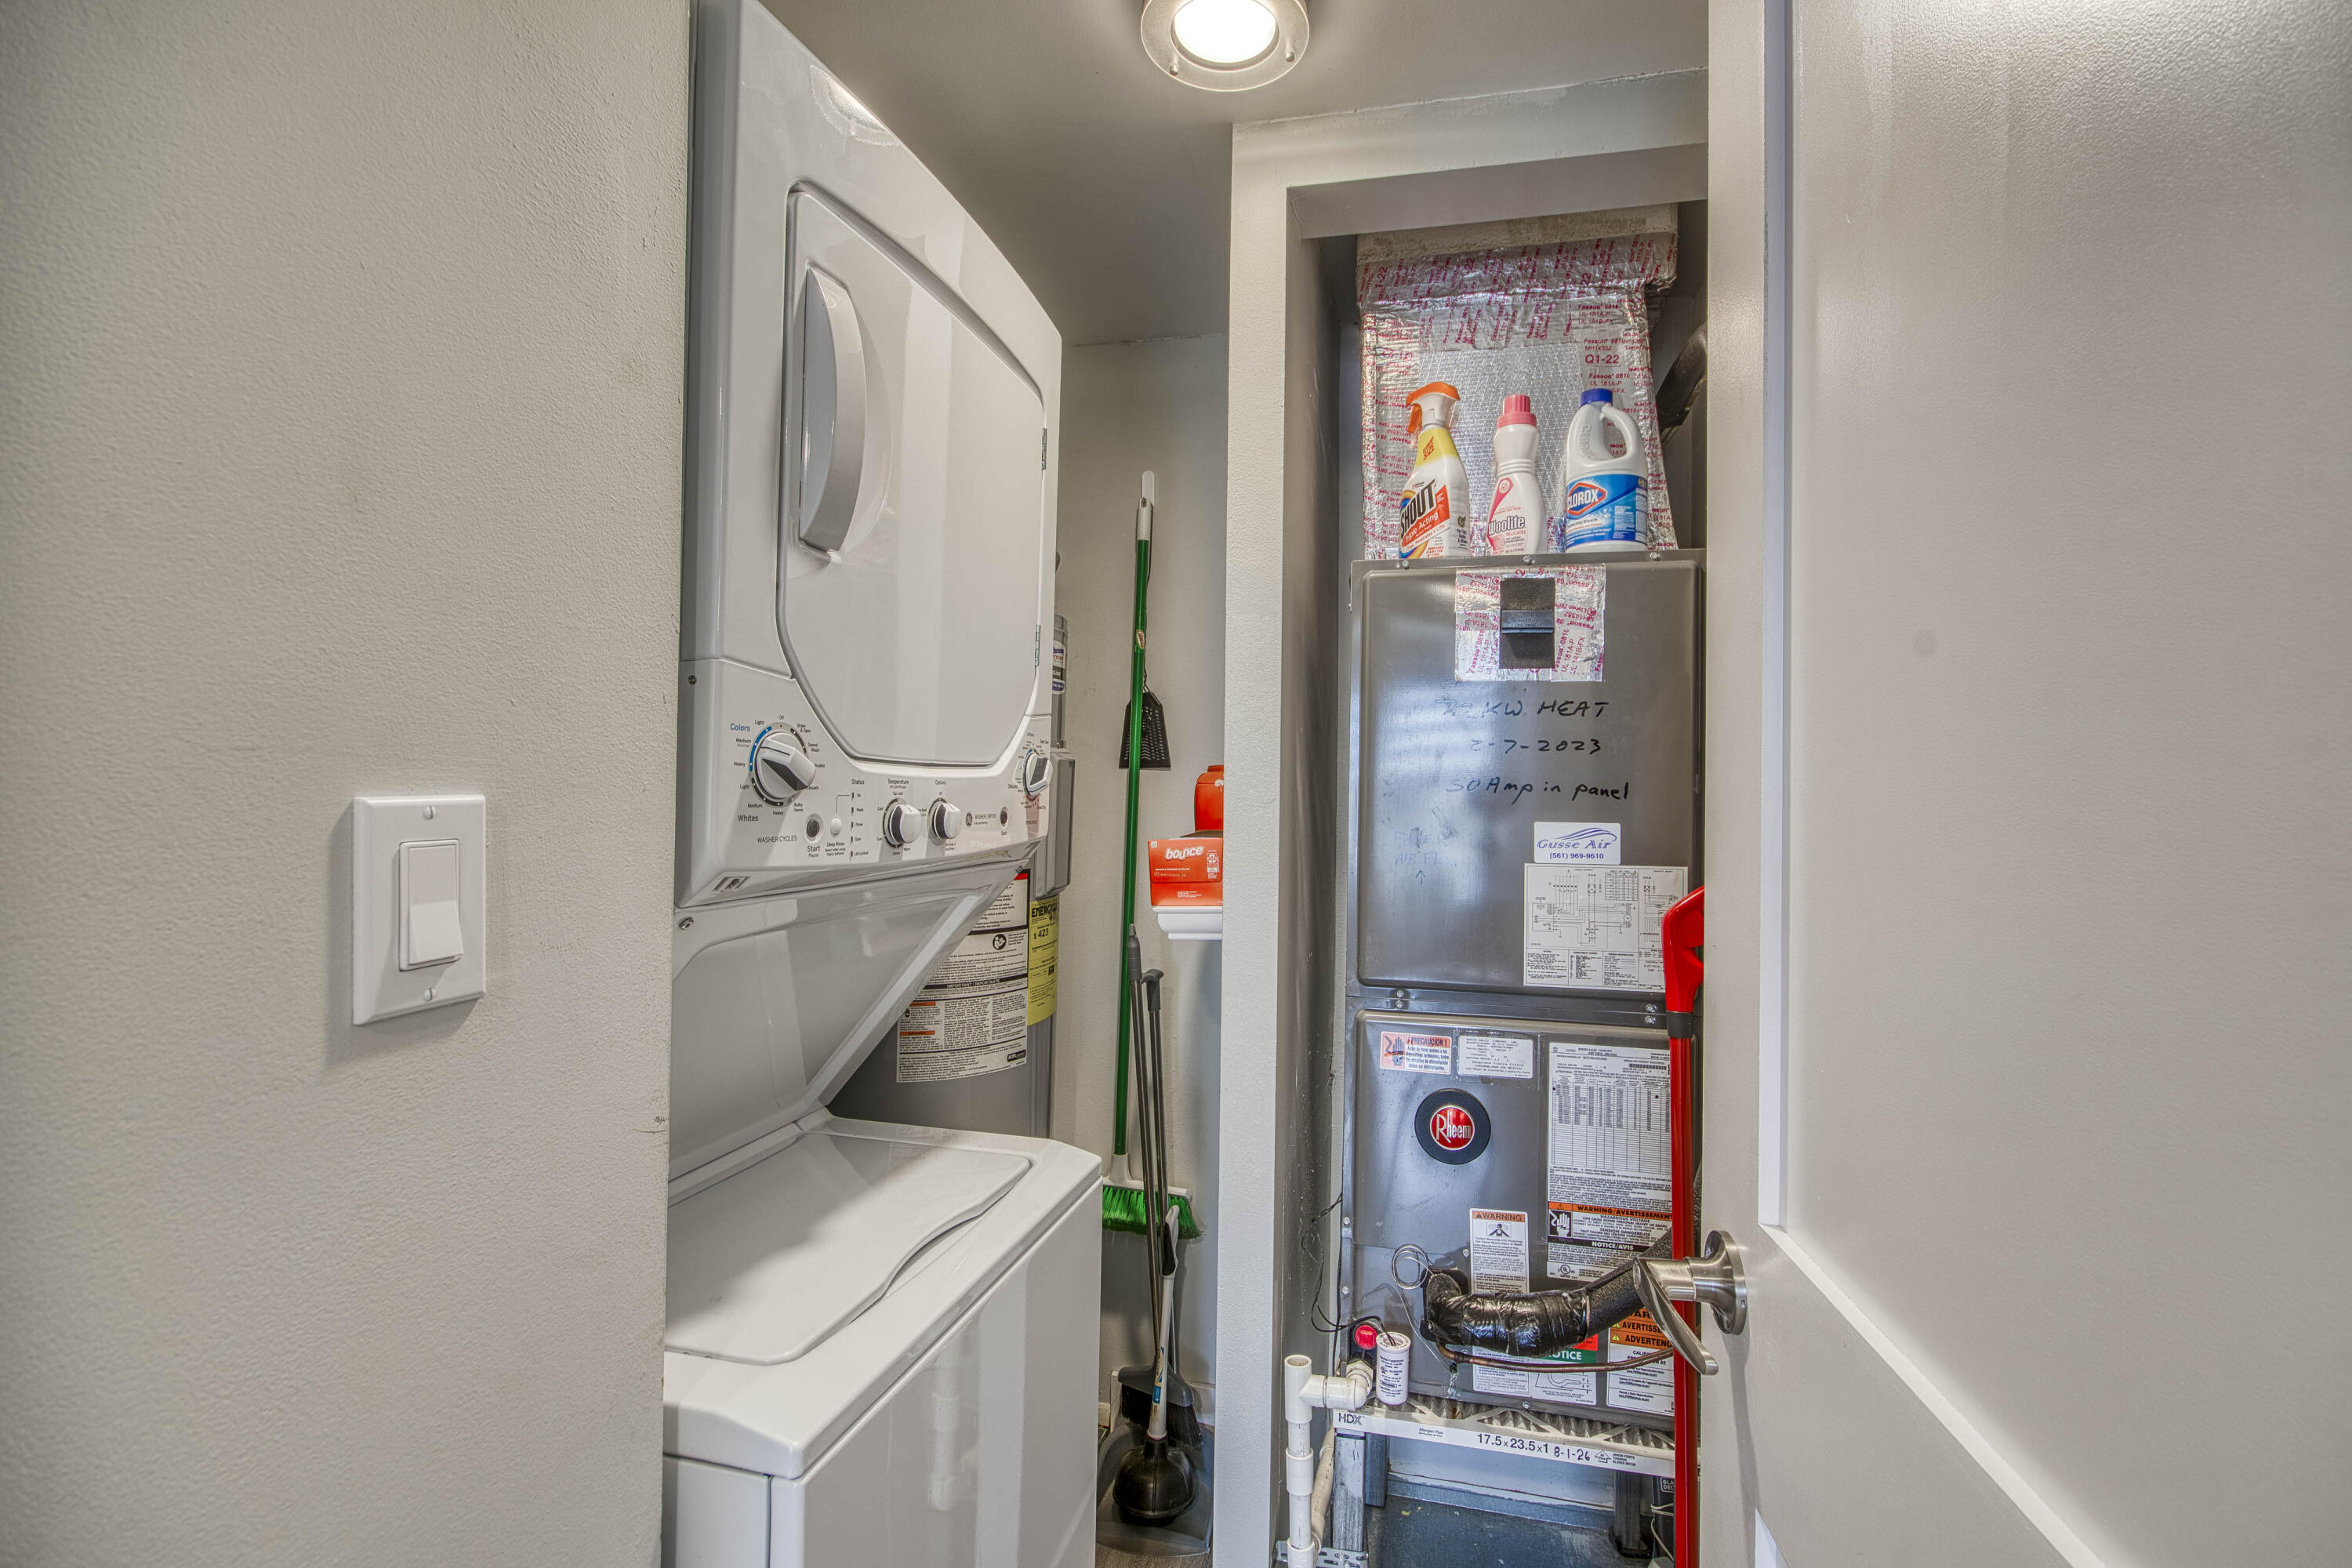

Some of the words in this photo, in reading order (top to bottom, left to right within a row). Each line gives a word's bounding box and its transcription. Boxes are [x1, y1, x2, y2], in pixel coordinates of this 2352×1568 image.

[1584, 354, 1620, 365] Q1-22
[1400, 478, 1436, 539] SHOUT
[1418, 513, 1439, 528] Acting
[1488, 515, 1526, 535] Woolite
[1537, 700, 1610, 717] HEAT
[730, 722, 750, 732] Colors
[1469, 739, 1602, 755] 2-7-2023
[1543, 782, 1562, 793] in
[1572, 782, 1629, 801] panel
[737, 814, 759, 822] Whites
[1537, 838, 1581, 849] Gusse
[1584, 839, 1613, 849] Air
[1165, 846, 1203, 861] bounce
[1436, 1109, 1472, 1144] Rheem
[1483, 1212, 1523, 1221] WARNING
[1592, 1241, 1634, 1250] NOTICE/AVIS
[1622, 1322, 1663, 1334] AVERTISSE
[1625, 1334, 1672, 1348] ADVERTENC
[1549, 1351, 1582, 1360] OTICE
[1338, 1412, 1362, 1425] HDX
[1554, 1446, 1591, 1461] 8-1-26
